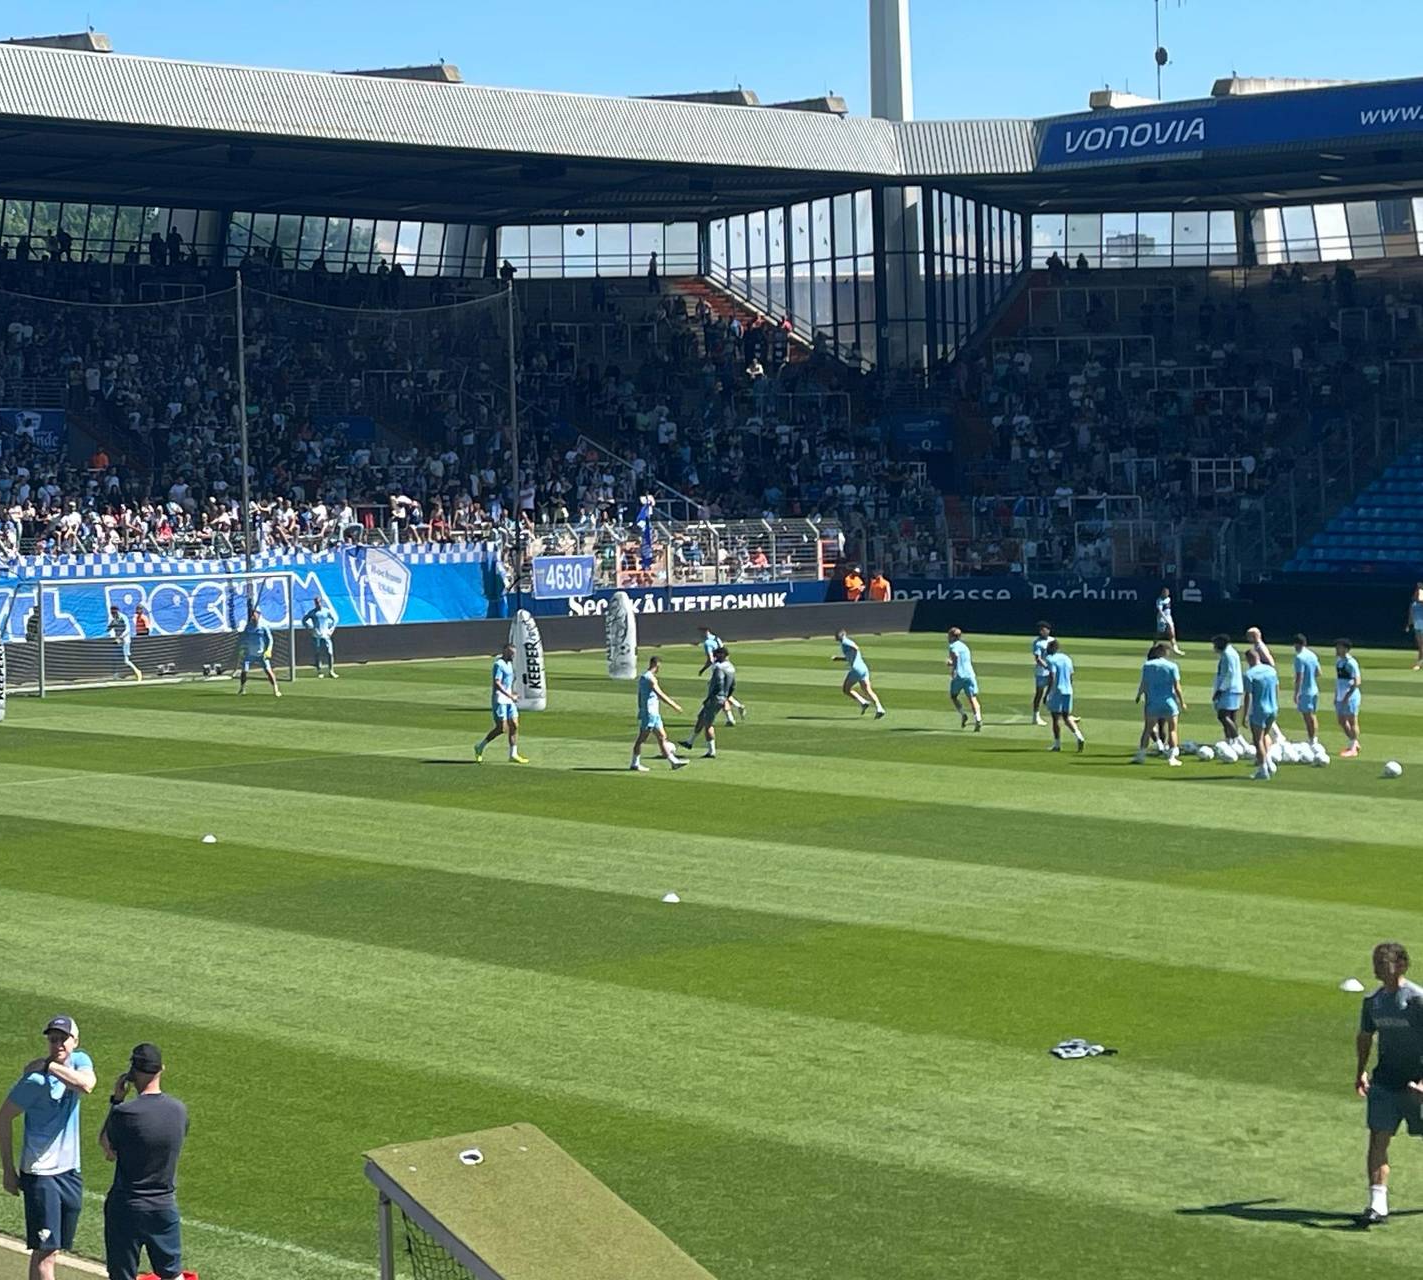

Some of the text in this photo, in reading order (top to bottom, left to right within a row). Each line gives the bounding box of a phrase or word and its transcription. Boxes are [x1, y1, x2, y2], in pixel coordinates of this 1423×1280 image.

[1065, 117, 1205, 154] VONOVIA
[545, 563, 583, 590] 4630
[893, 582, 1138, 600] parkasse Bochum
[105, 571, 339, 636] BOCHUM
